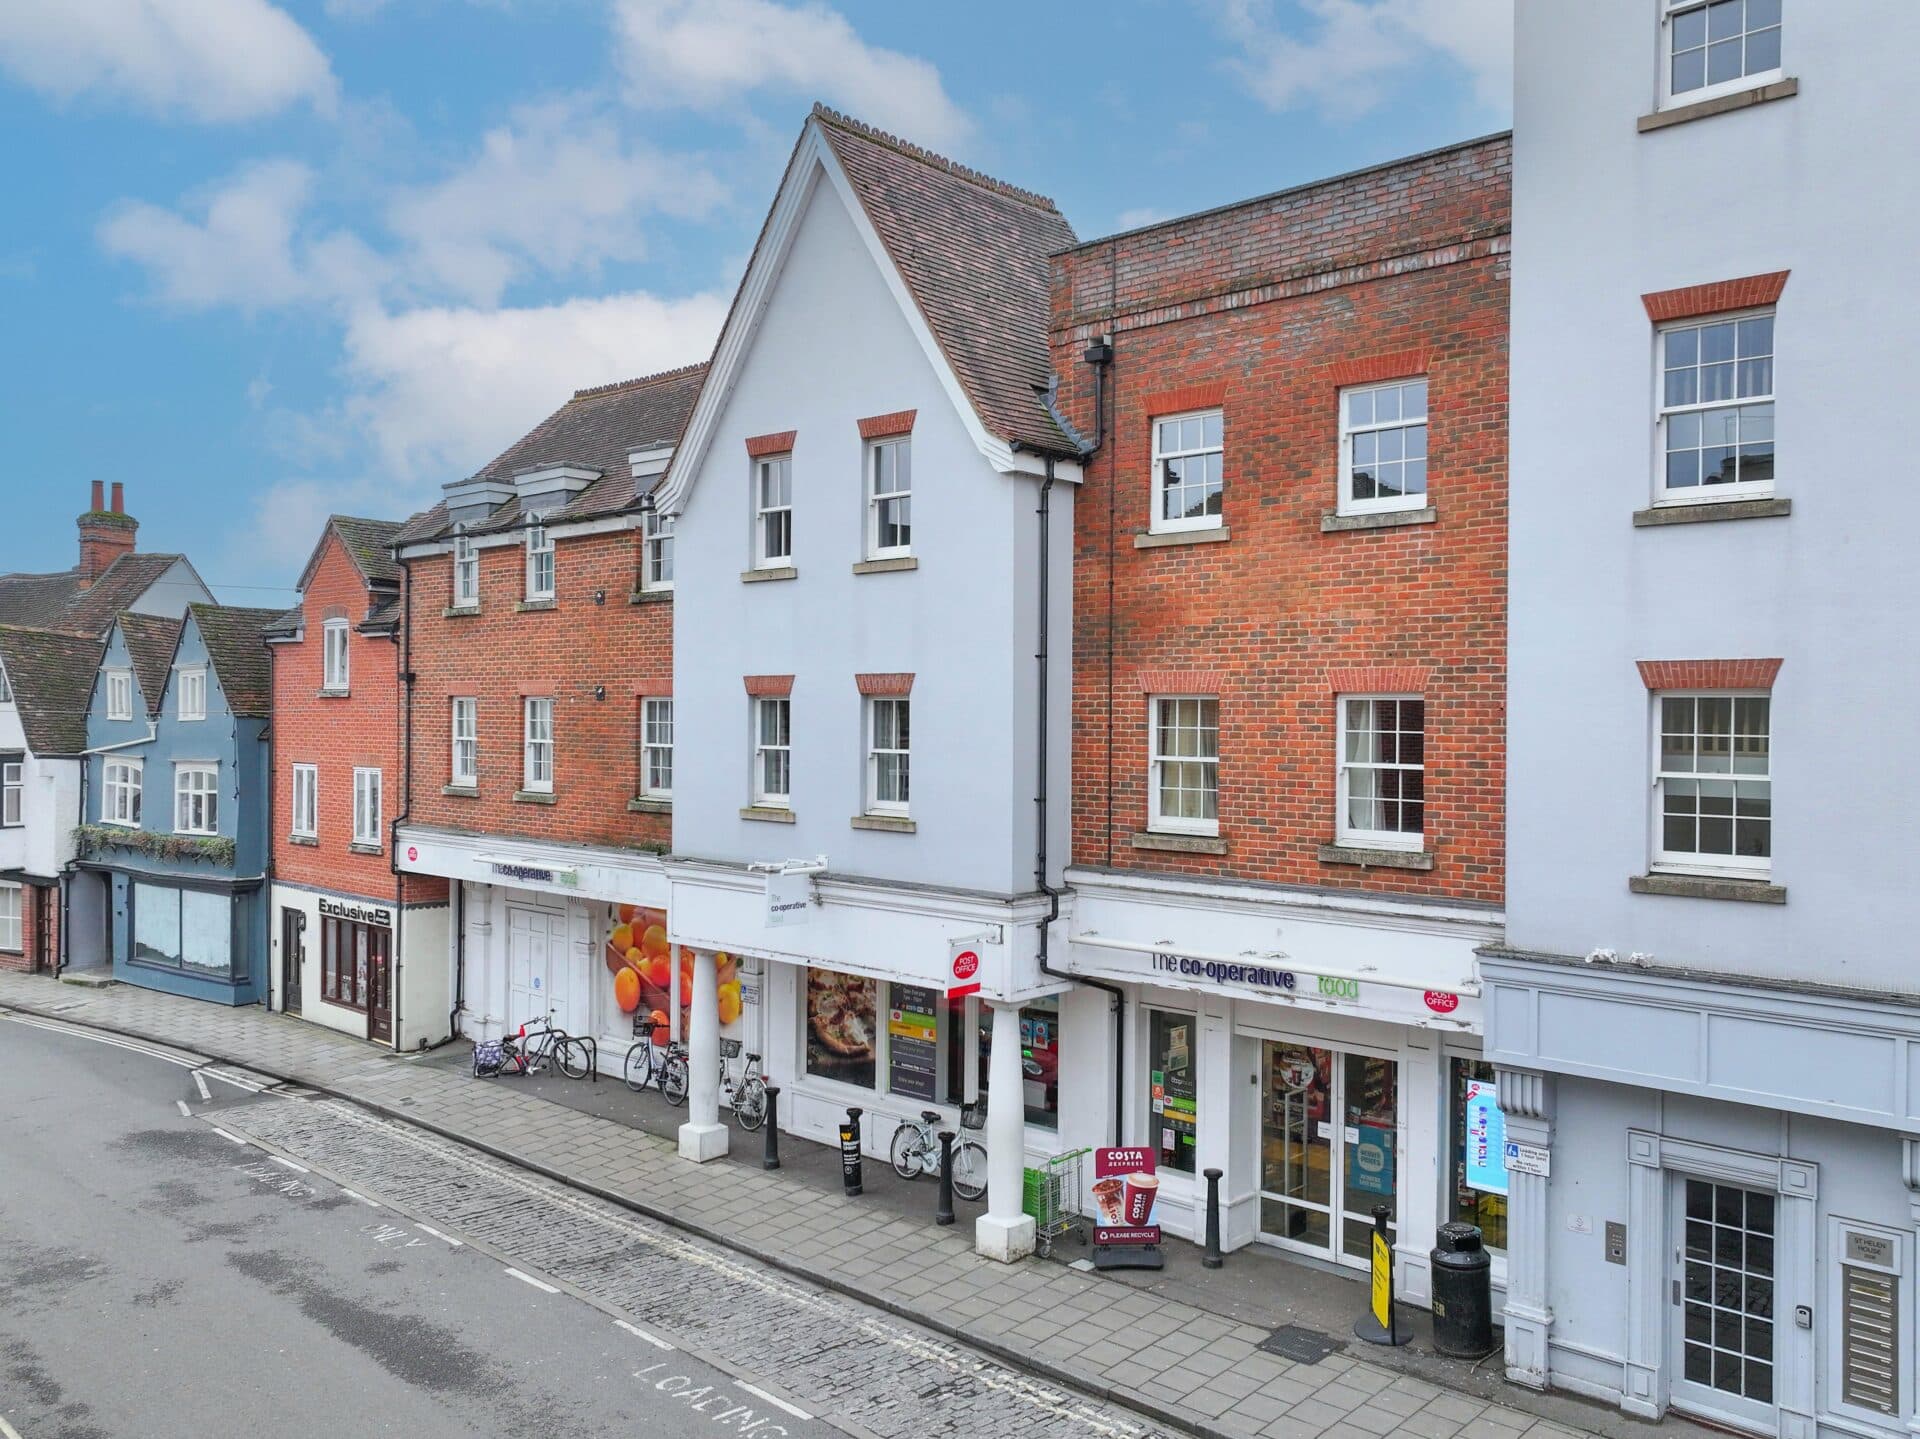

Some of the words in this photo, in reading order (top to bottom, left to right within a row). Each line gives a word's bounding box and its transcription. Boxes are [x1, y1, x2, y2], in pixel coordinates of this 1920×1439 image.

[319, 898, 374, 922] Exclusive
[771, 902, 807, 912] co-operative
[959, 955, 975, 966] POST
[954, 963, 977, 975] OFFICE
[1179, 957, 1296, 989] co-operative
[1431, 991, 1451, 1000] POST
[1426, 997, 1455, 1009] OFFICE
[1107, 1151, 1143, 1161] COSTA
[1131, 1193, 1144, 1219] COSTA
[1131, 1231, 1155, 1239] RECYCLE
[1864, 1239, 1886, 1249] HELEN
[1858, 1245, 1881, 1255] HOUSE
[632, 1363, 788, 1438] LOADING
